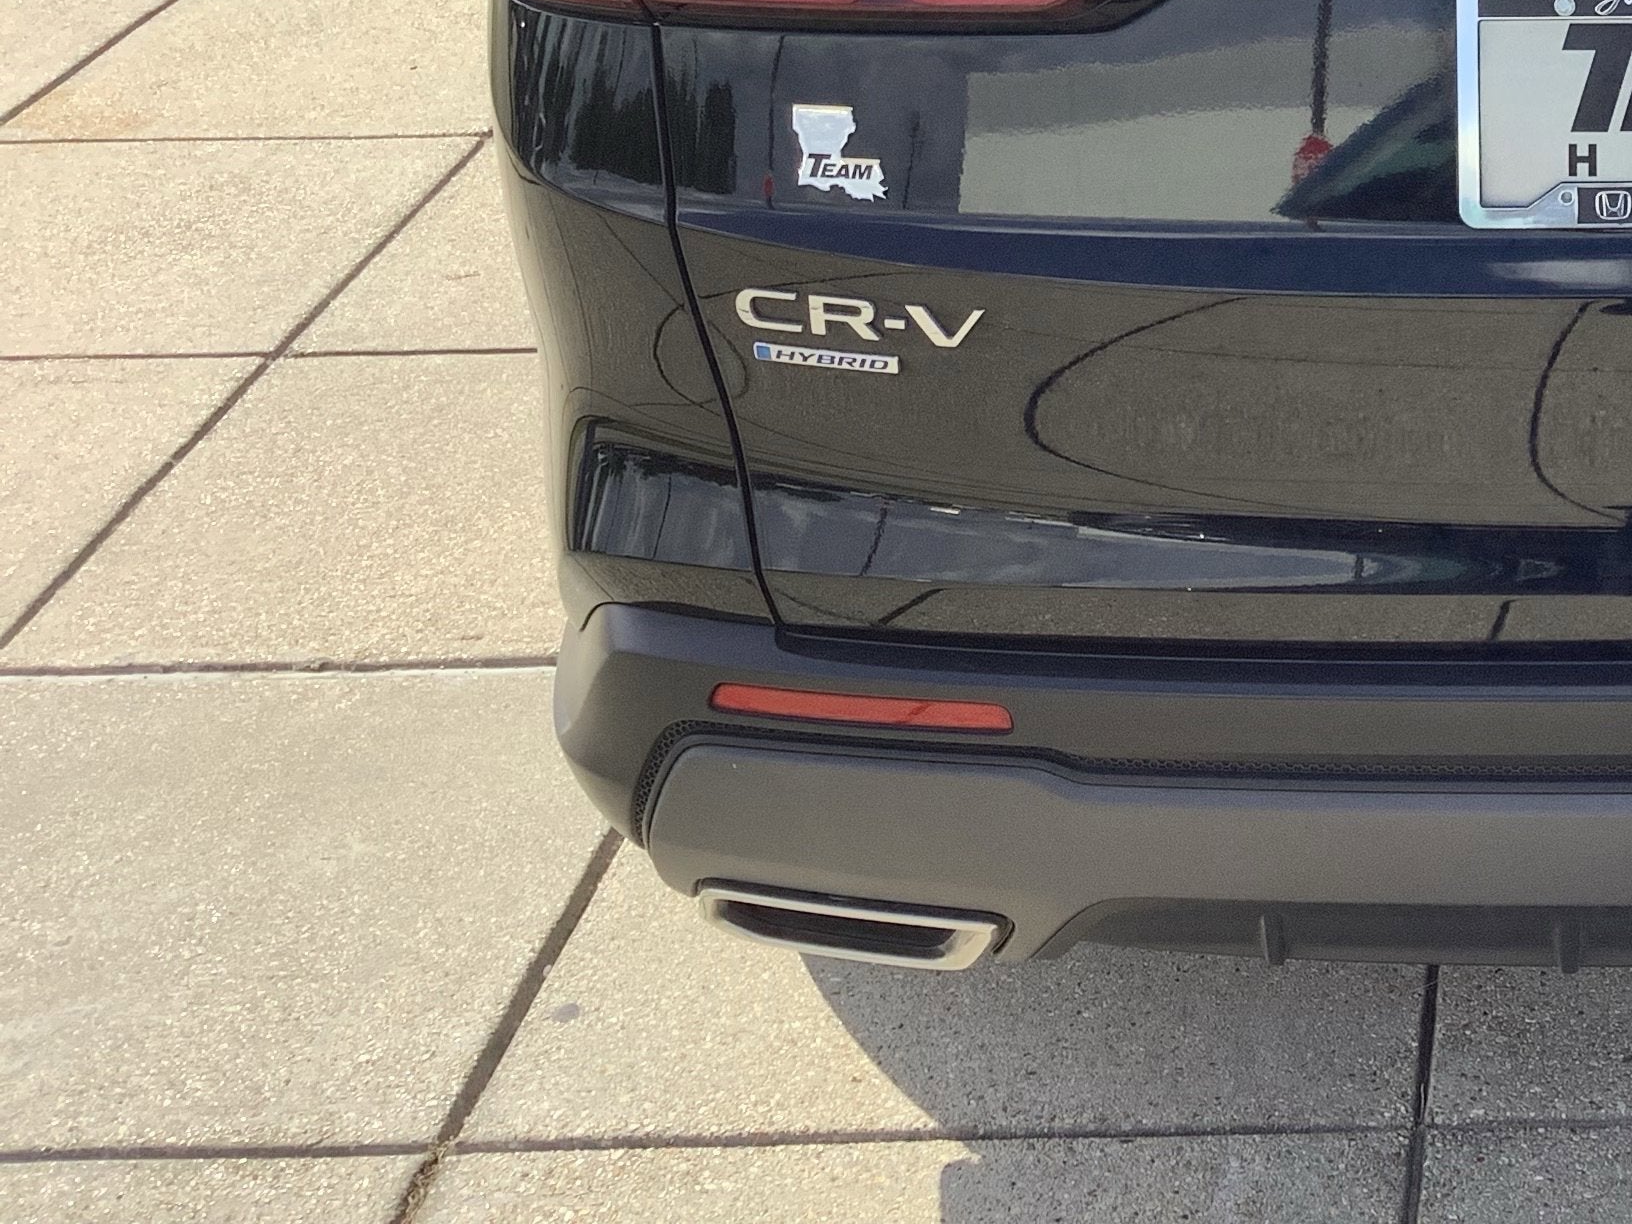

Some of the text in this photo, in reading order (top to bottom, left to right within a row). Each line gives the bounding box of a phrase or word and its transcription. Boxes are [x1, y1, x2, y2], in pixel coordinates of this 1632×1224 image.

[808, 152, 873, 181] TEAM
[734, 287, 986, 349] CR-V
[775, 349, 890, 372] HYBRID
